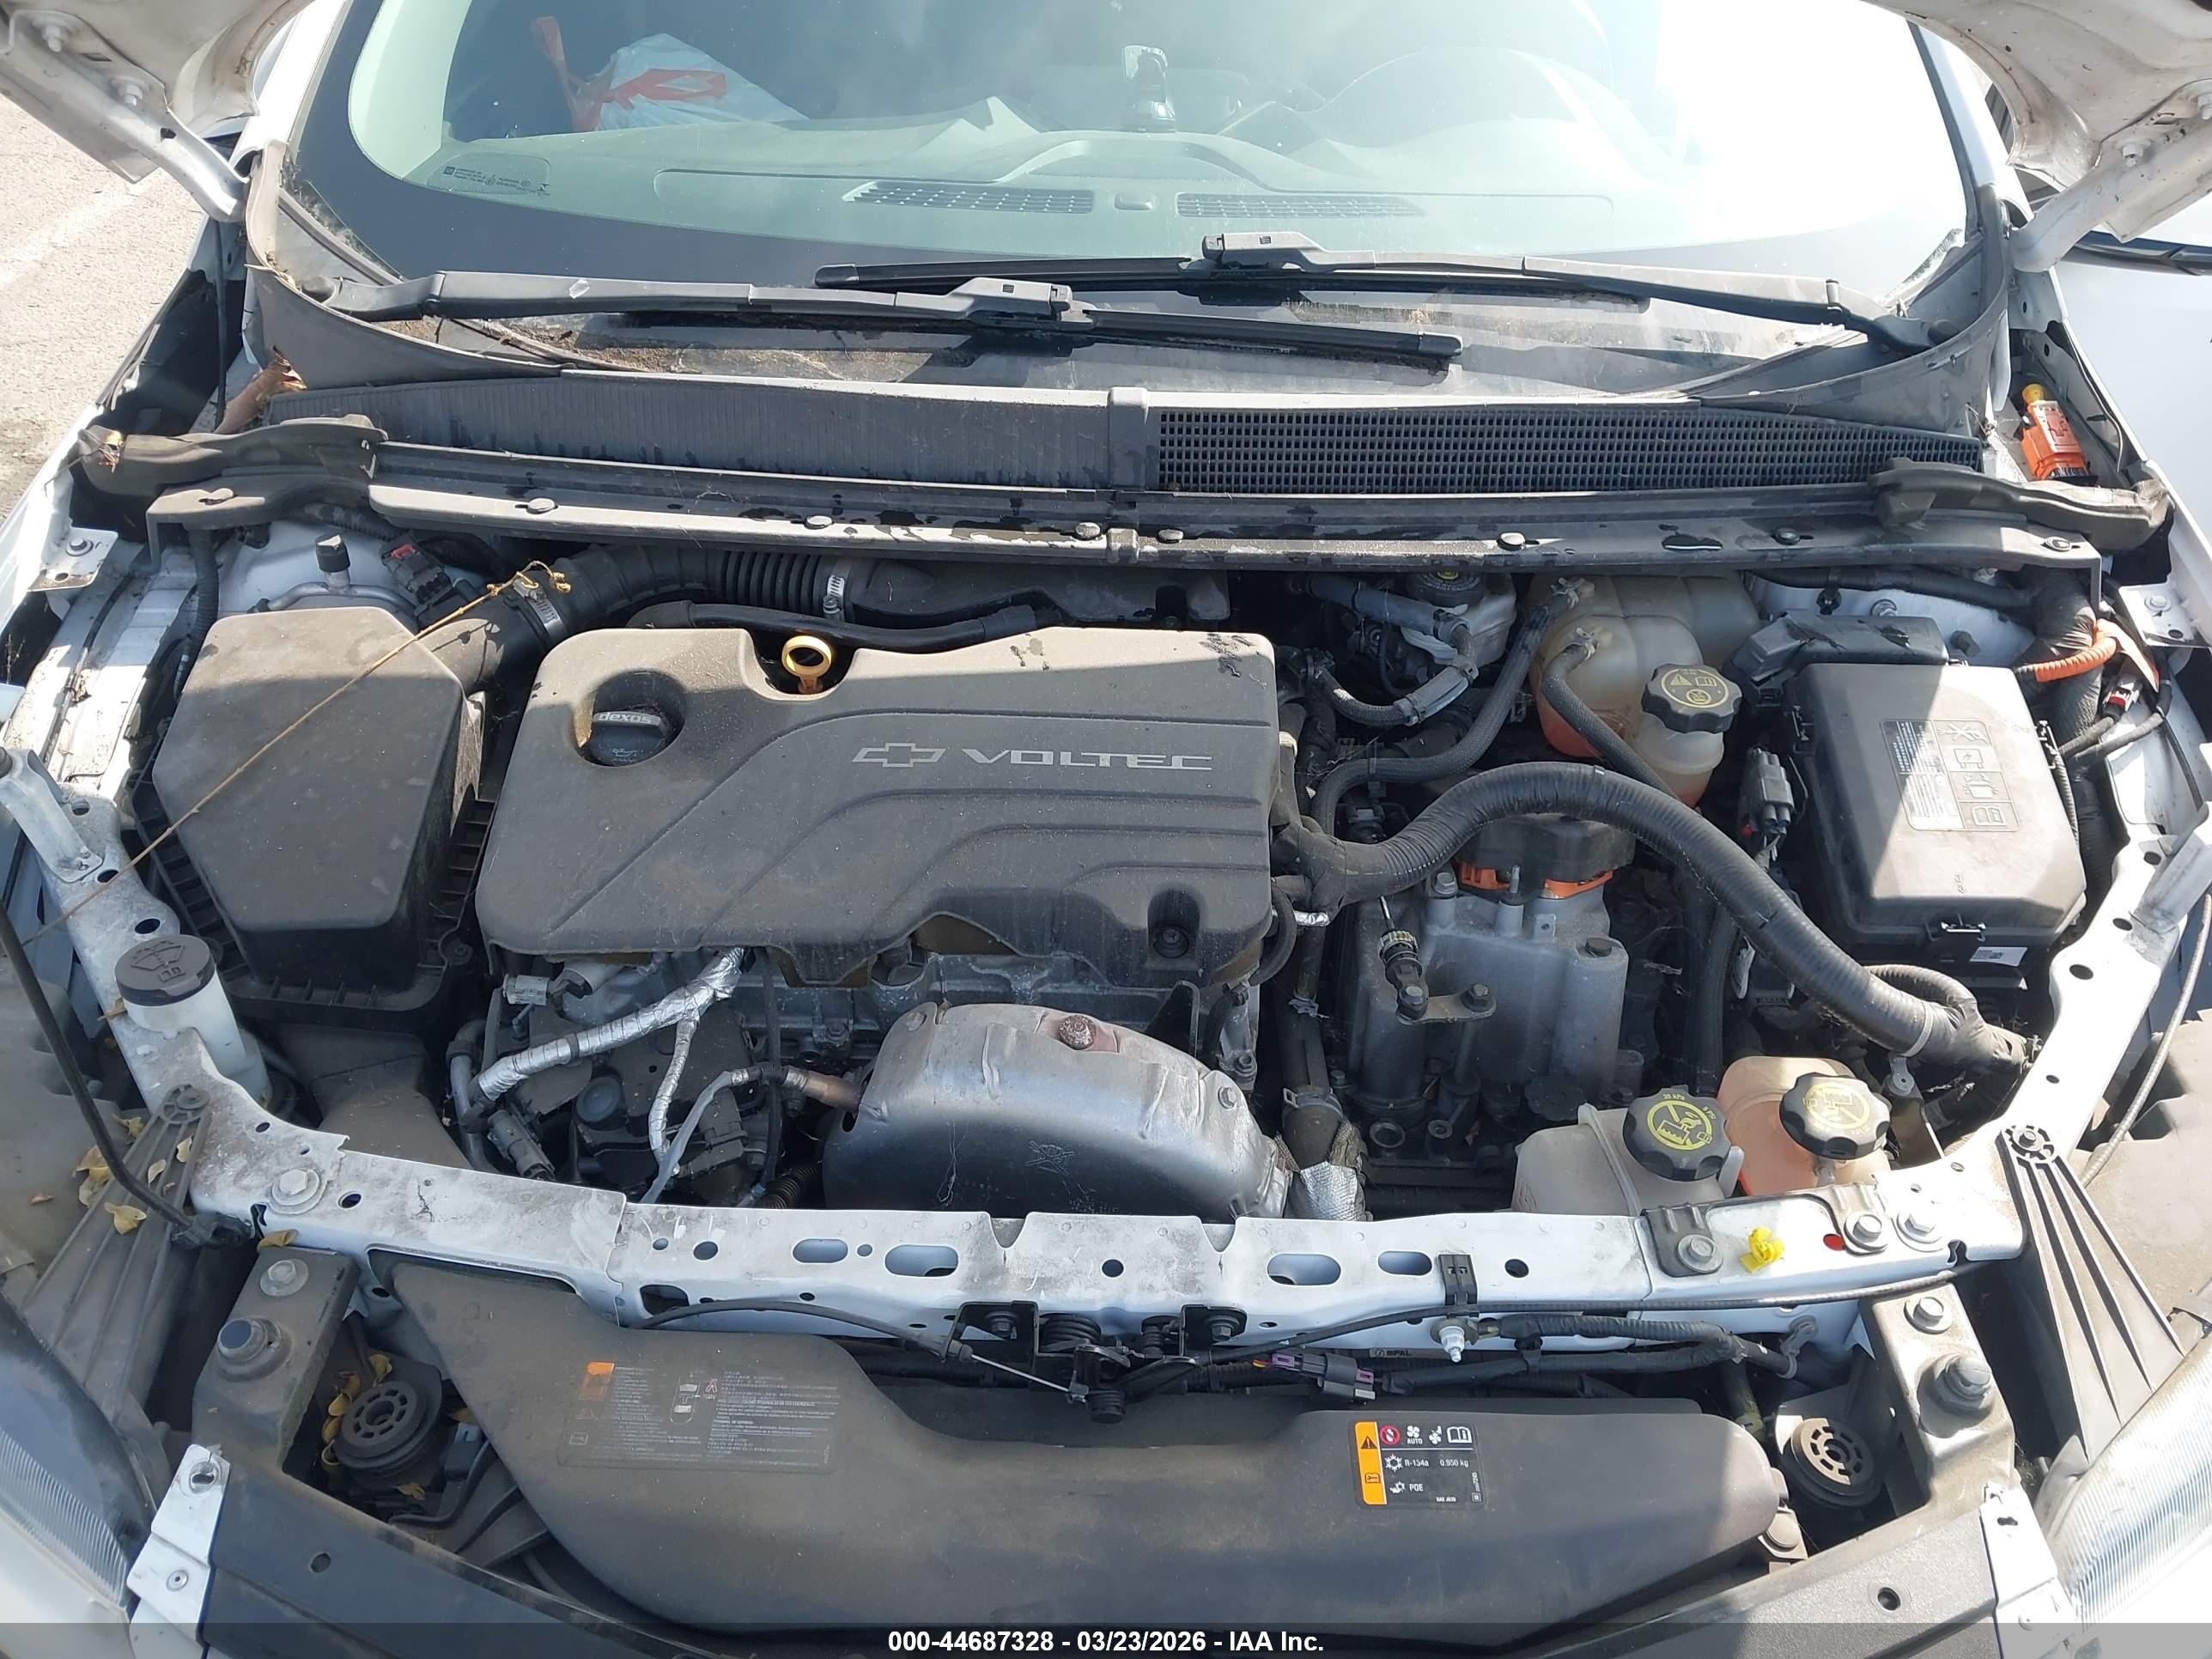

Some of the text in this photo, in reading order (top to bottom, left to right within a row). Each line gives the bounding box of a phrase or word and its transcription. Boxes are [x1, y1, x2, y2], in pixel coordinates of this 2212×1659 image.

[599, 712, 651, 724] dexos
[962, 748, 1212, 771] VOLTEC
[1404, 1459, 1430, 1468] R-134a
[1460, 1459, 1469, 1468] kg
[1409, 1483, 1424, 1492] POE
